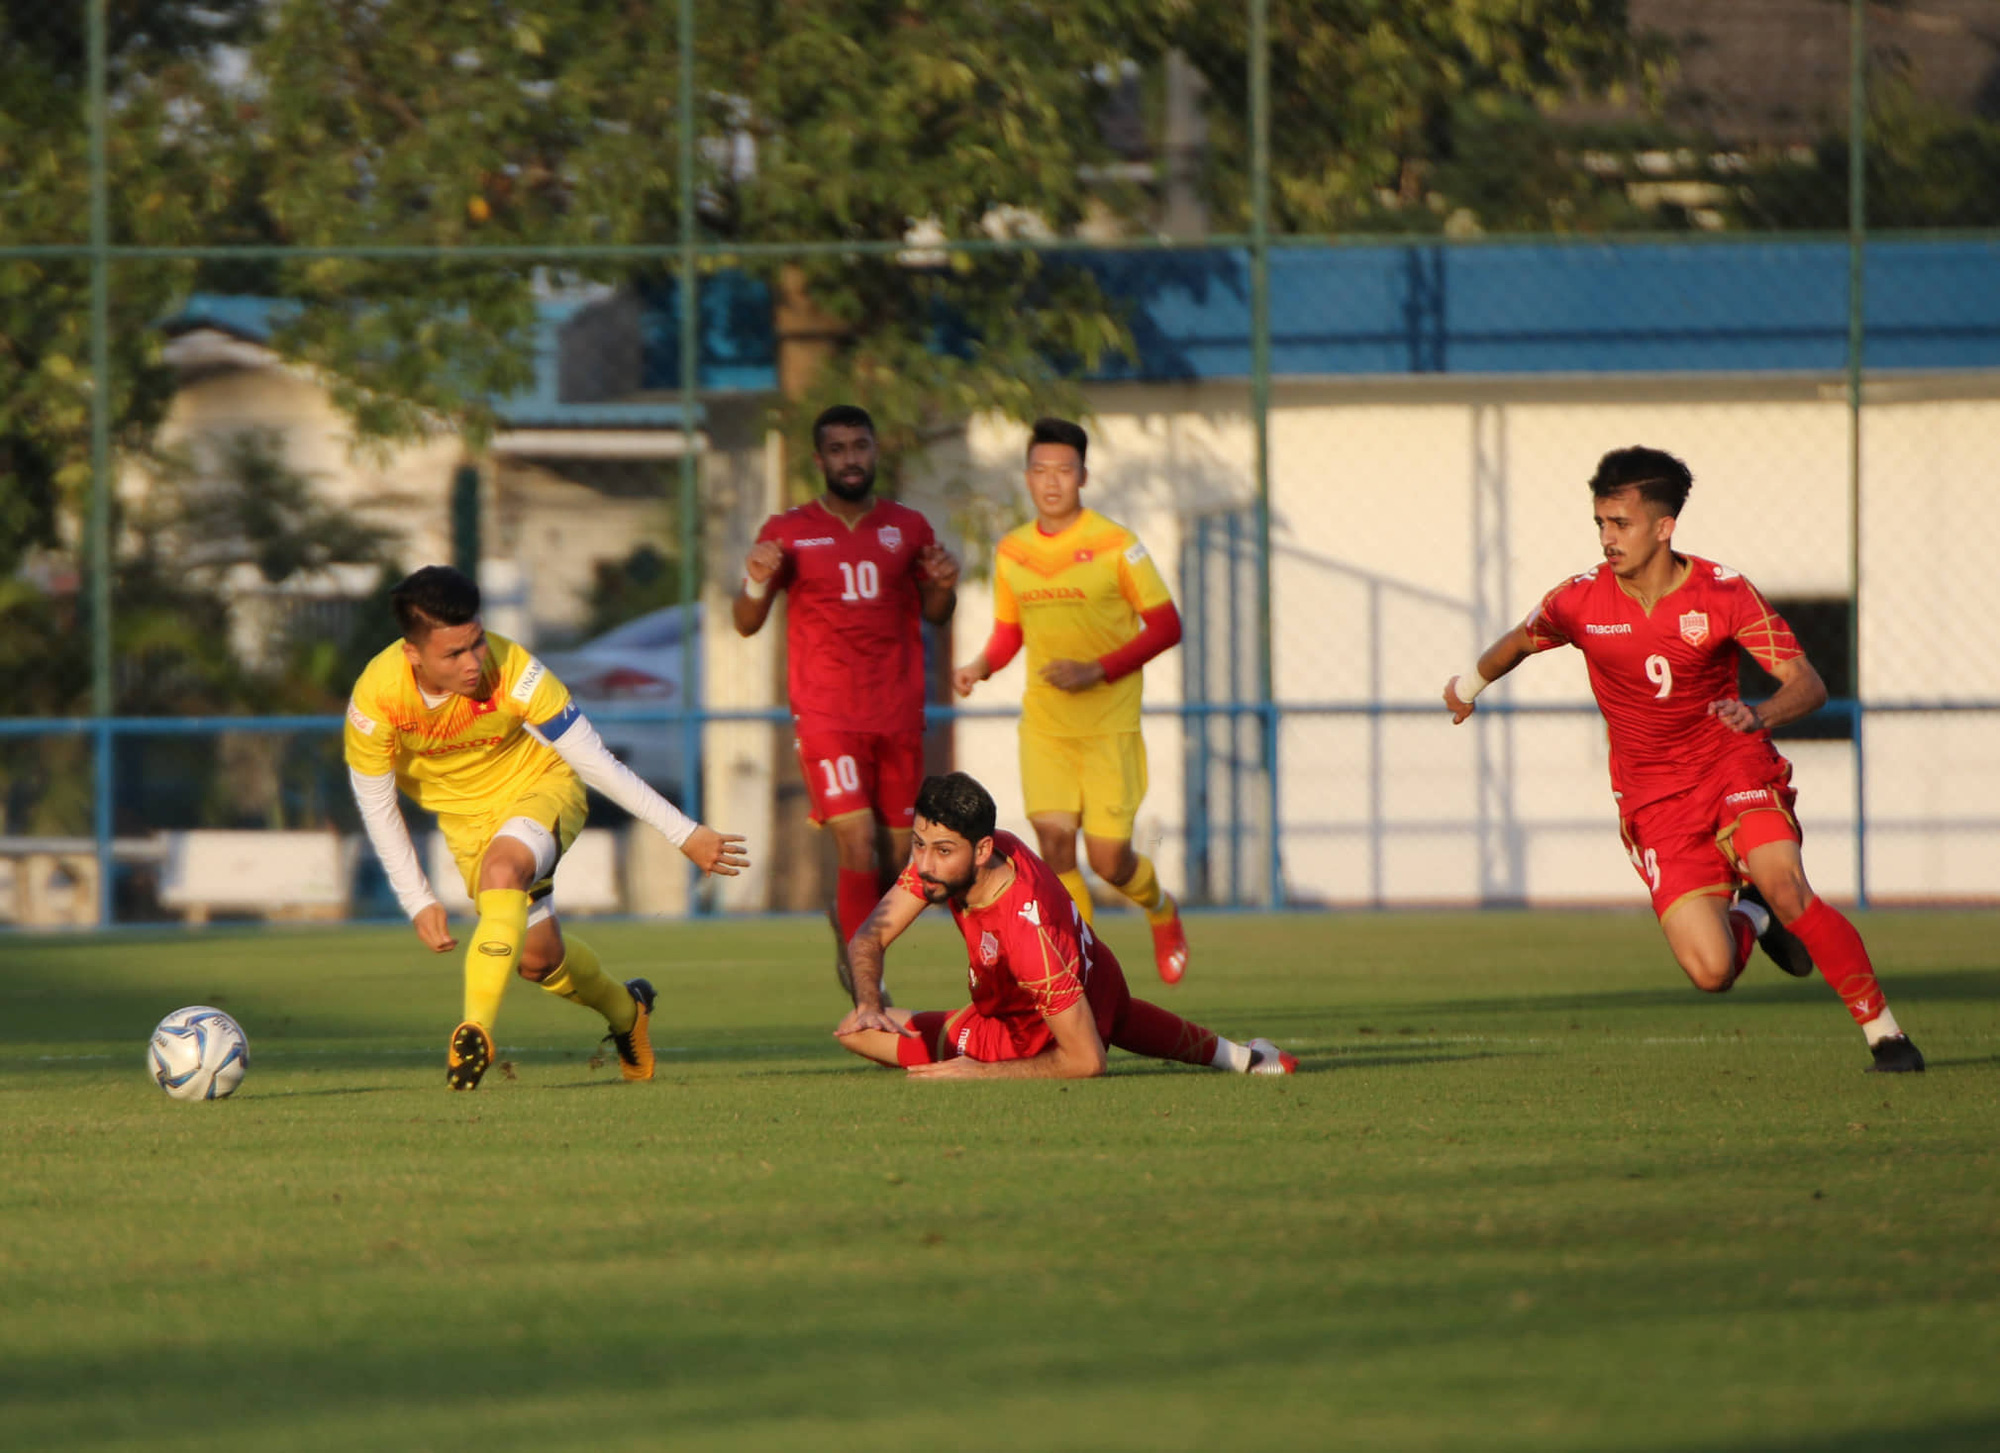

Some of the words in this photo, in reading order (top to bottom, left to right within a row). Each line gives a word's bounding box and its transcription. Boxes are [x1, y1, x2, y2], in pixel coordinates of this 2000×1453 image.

[839, 561, 878, 601] 10
[1585, 623, 1632, 635] macron
[1645, 654, 1673, 699] 9
[819, 755, 860, 797] 10
[1644, 848, 1660, 892] 9
